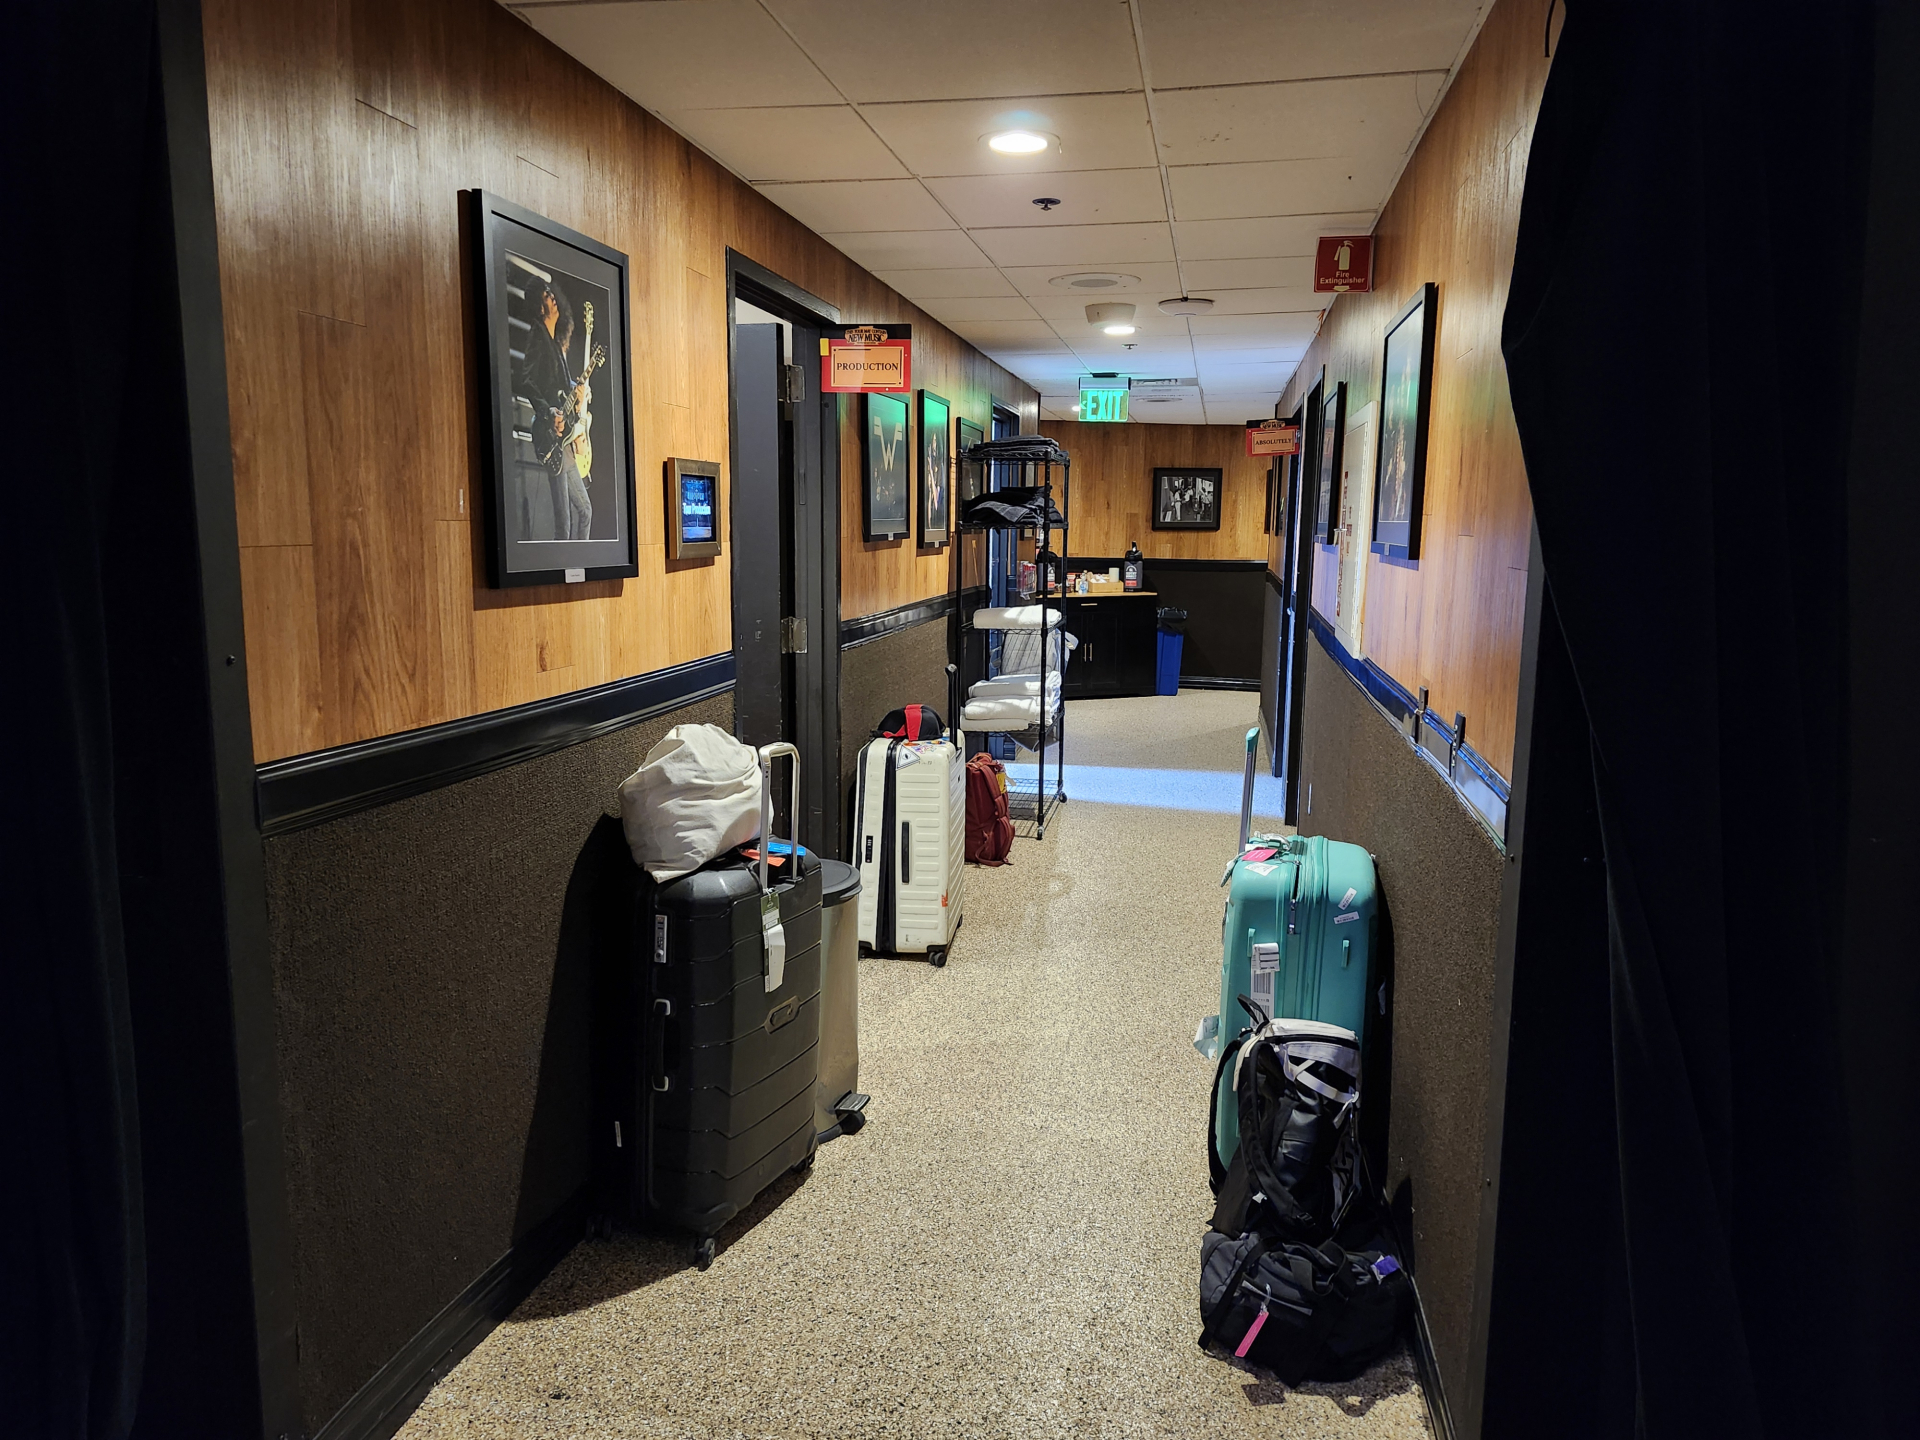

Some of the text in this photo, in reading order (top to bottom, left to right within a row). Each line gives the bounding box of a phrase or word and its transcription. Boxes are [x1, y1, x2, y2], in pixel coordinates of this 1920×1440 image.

[1319, 277, 1365, 285] Extinguisher
[848, 334, 885, 342] NEW MUSIC
[836, 362, 899, 371] PRODUCTION
[1086, 390, 1124, 420] EXIT
[1255, 438, 1292, 446] ABSOLUTELY
